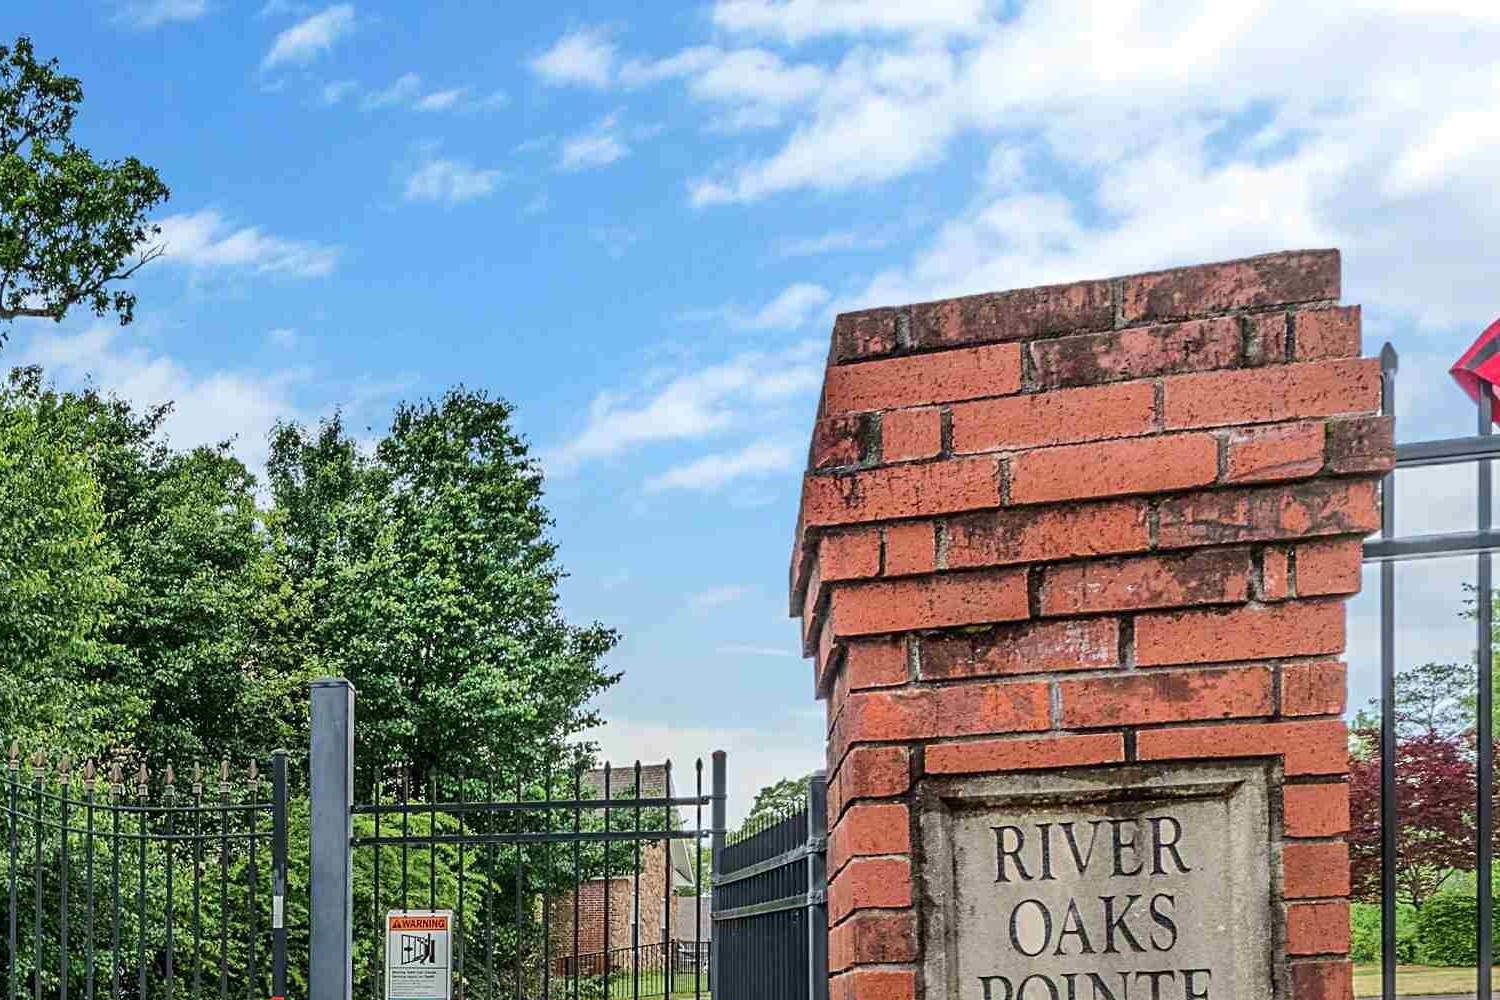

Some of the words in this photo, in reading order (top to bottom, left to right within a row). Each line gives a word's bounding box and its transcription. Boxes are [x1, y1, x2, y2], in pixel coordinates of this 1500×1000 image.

[990, 816, 1191, 883] RIVER
[403, 919, 445, 928] WARNING
[1008, 893, 1178, 957] OAKS
